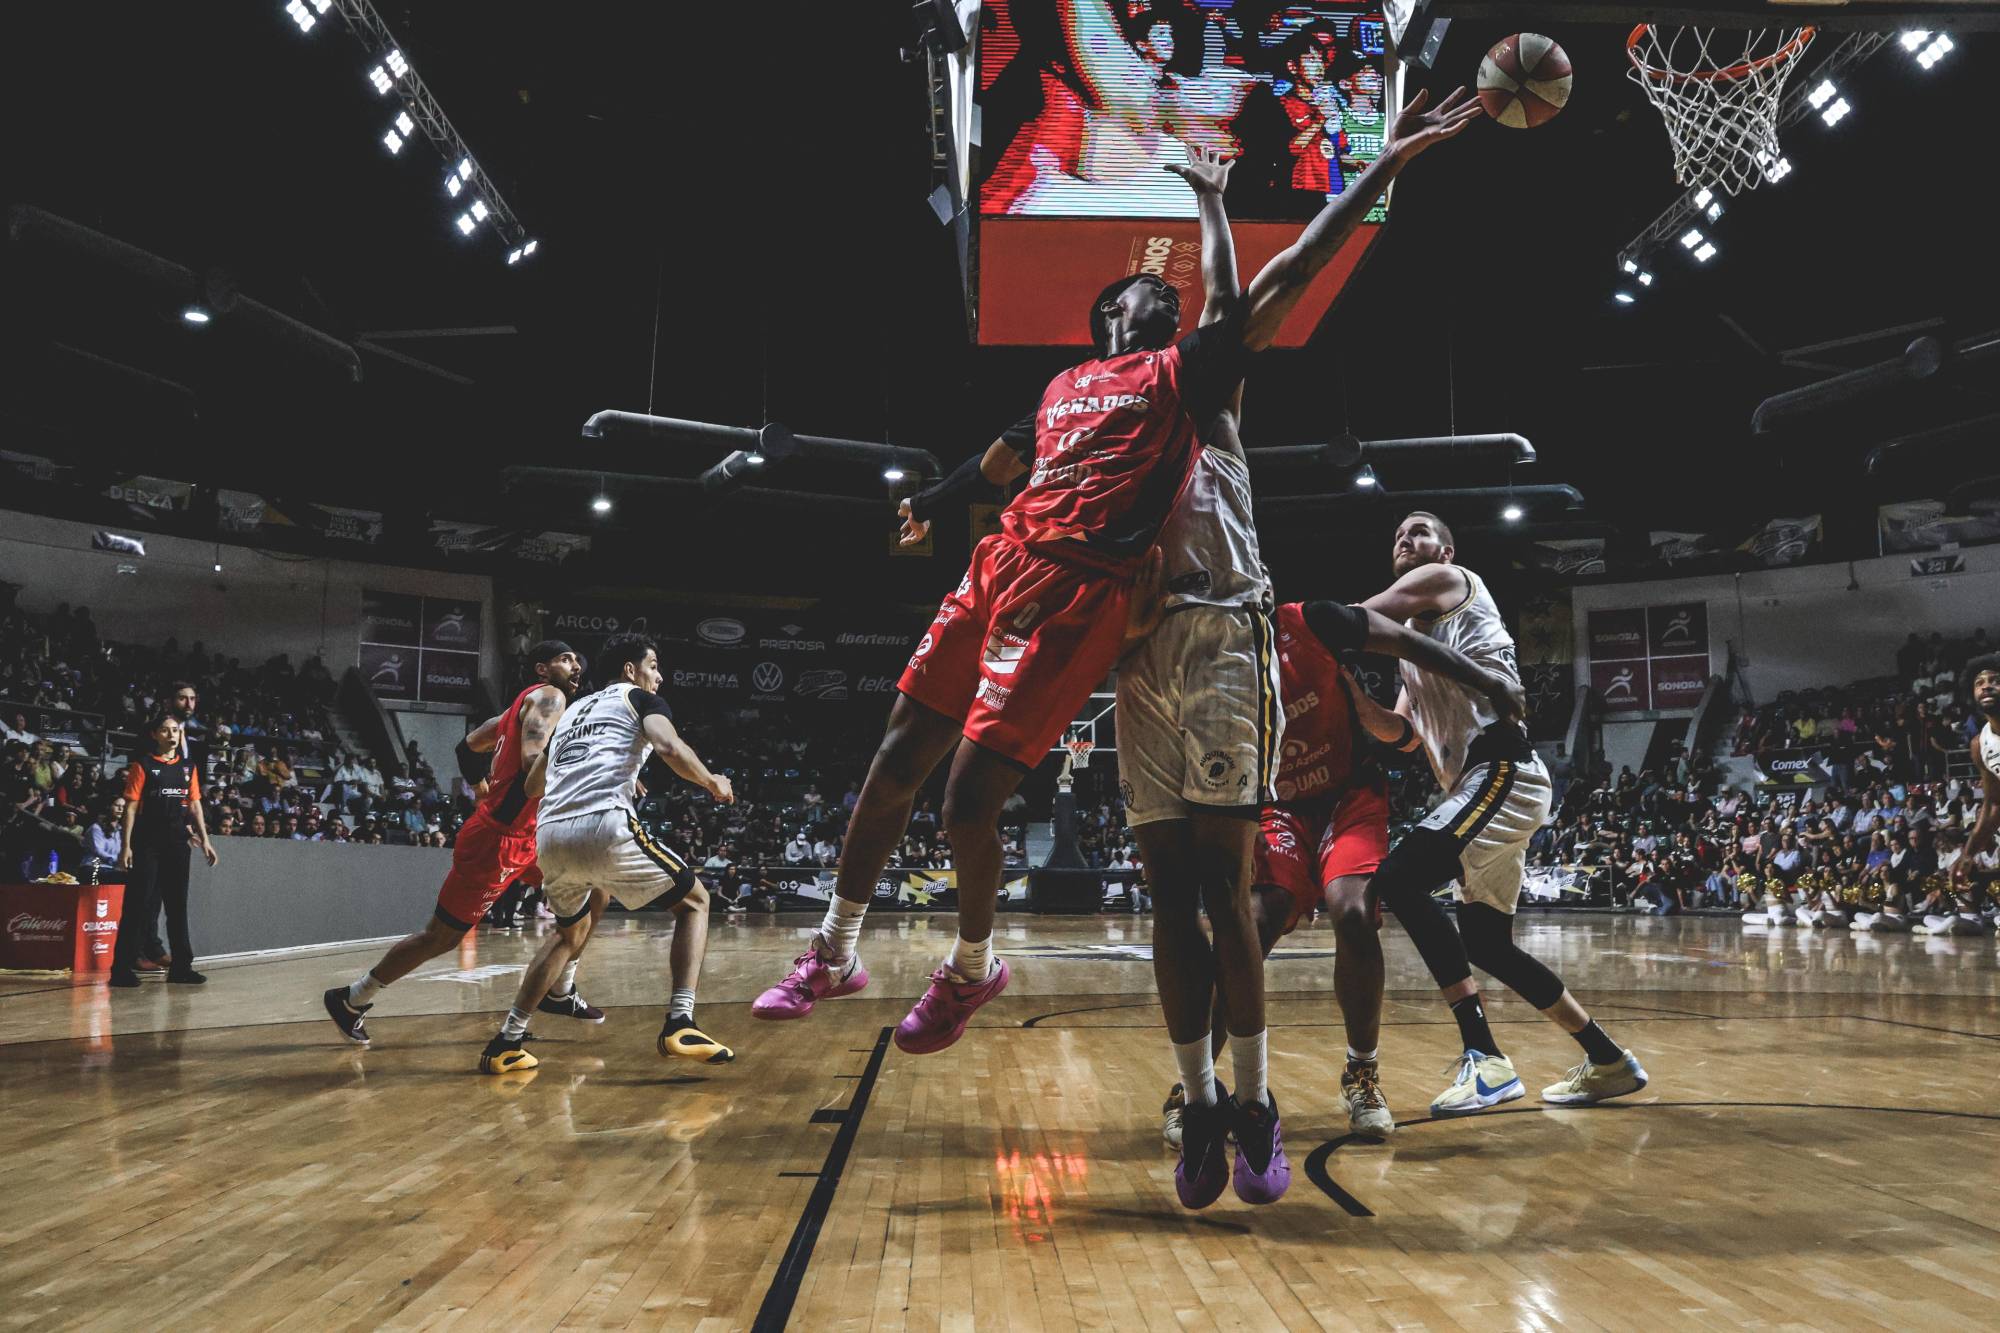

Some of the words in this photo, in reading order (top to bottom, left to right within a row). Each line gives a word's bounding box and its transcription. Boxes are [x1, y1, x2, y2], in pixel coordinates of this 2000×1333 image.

[555, 614, 603, 630] ARCO
[426, 673, 472, 686] SONORA
[856, 675, 897, 692] telc
[1657, 680, 1705, 691] SONORA
[1771, 756, 1813, 772] Comex
[7, 911, 68, 933] Caliente
